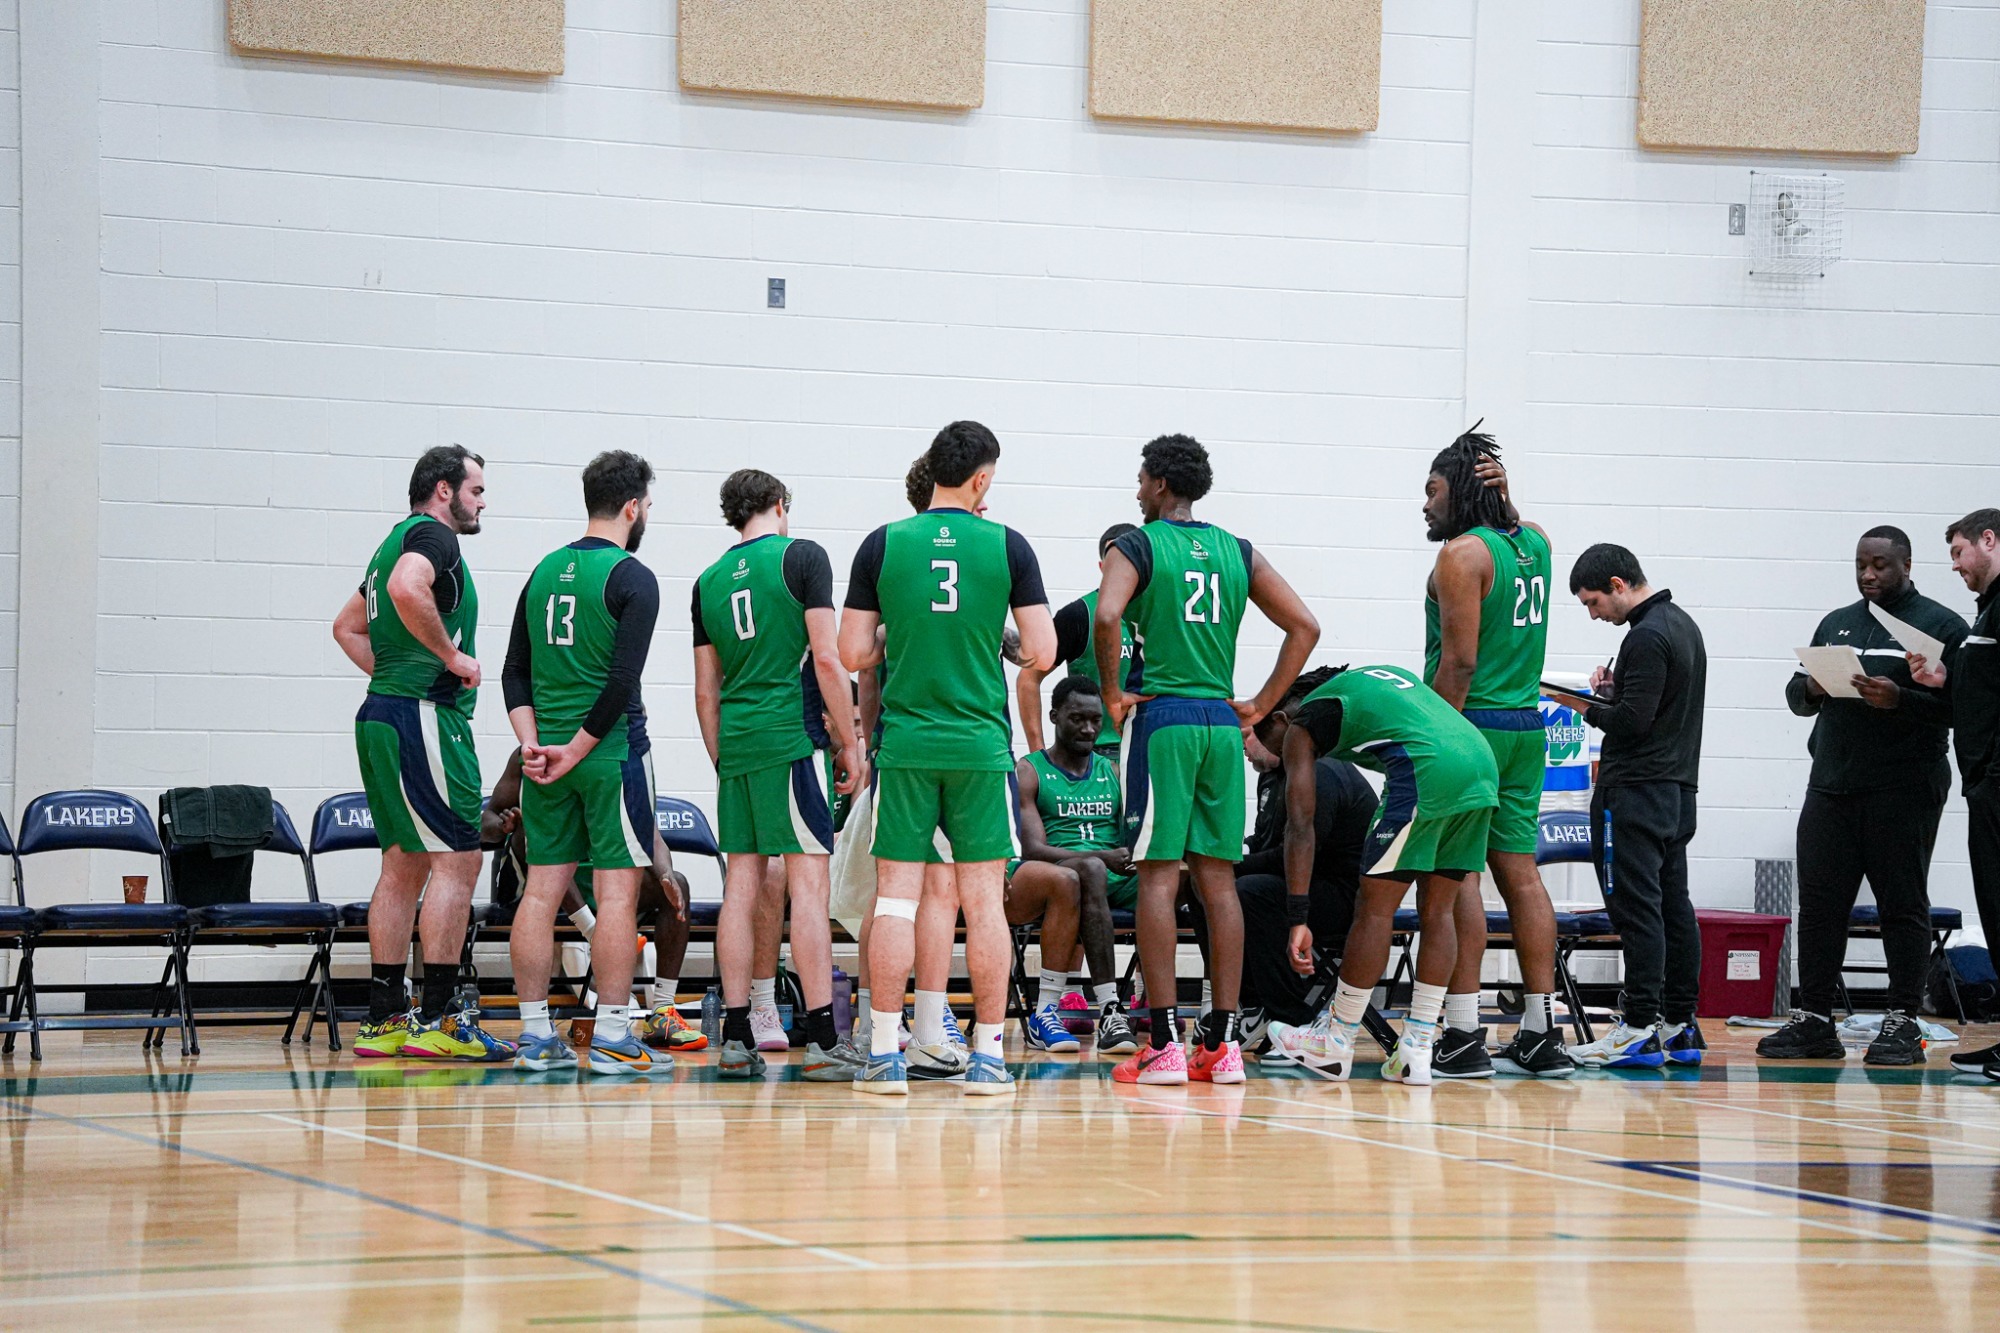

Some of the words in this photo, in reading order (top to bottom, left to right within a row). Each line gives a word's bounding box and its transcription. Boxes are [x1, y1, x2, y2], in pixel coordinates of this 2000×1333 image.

[366, 569, 379, 624] 16
[930, 559, 959, 613] 3
[1184, 570, 1221, 624] 21
[1513, 574, 1545, 627] 20
[545, 593, 577, 647] 13
[730, 588, 756, 641] 0
[1362, 668, 1416, 690] 9
[1545, 725, 1585, 743] AKERS
[1056, 793, 1112, 801] NIPISSING
[44, 806, 136, 827] LAKERS
[332, 808, 375, 828] LAK
[1057, 801, 1113, 817] LAKERS
[656, 810, 694, 830] ERS
[1078, 822, 1095, 841] 11
